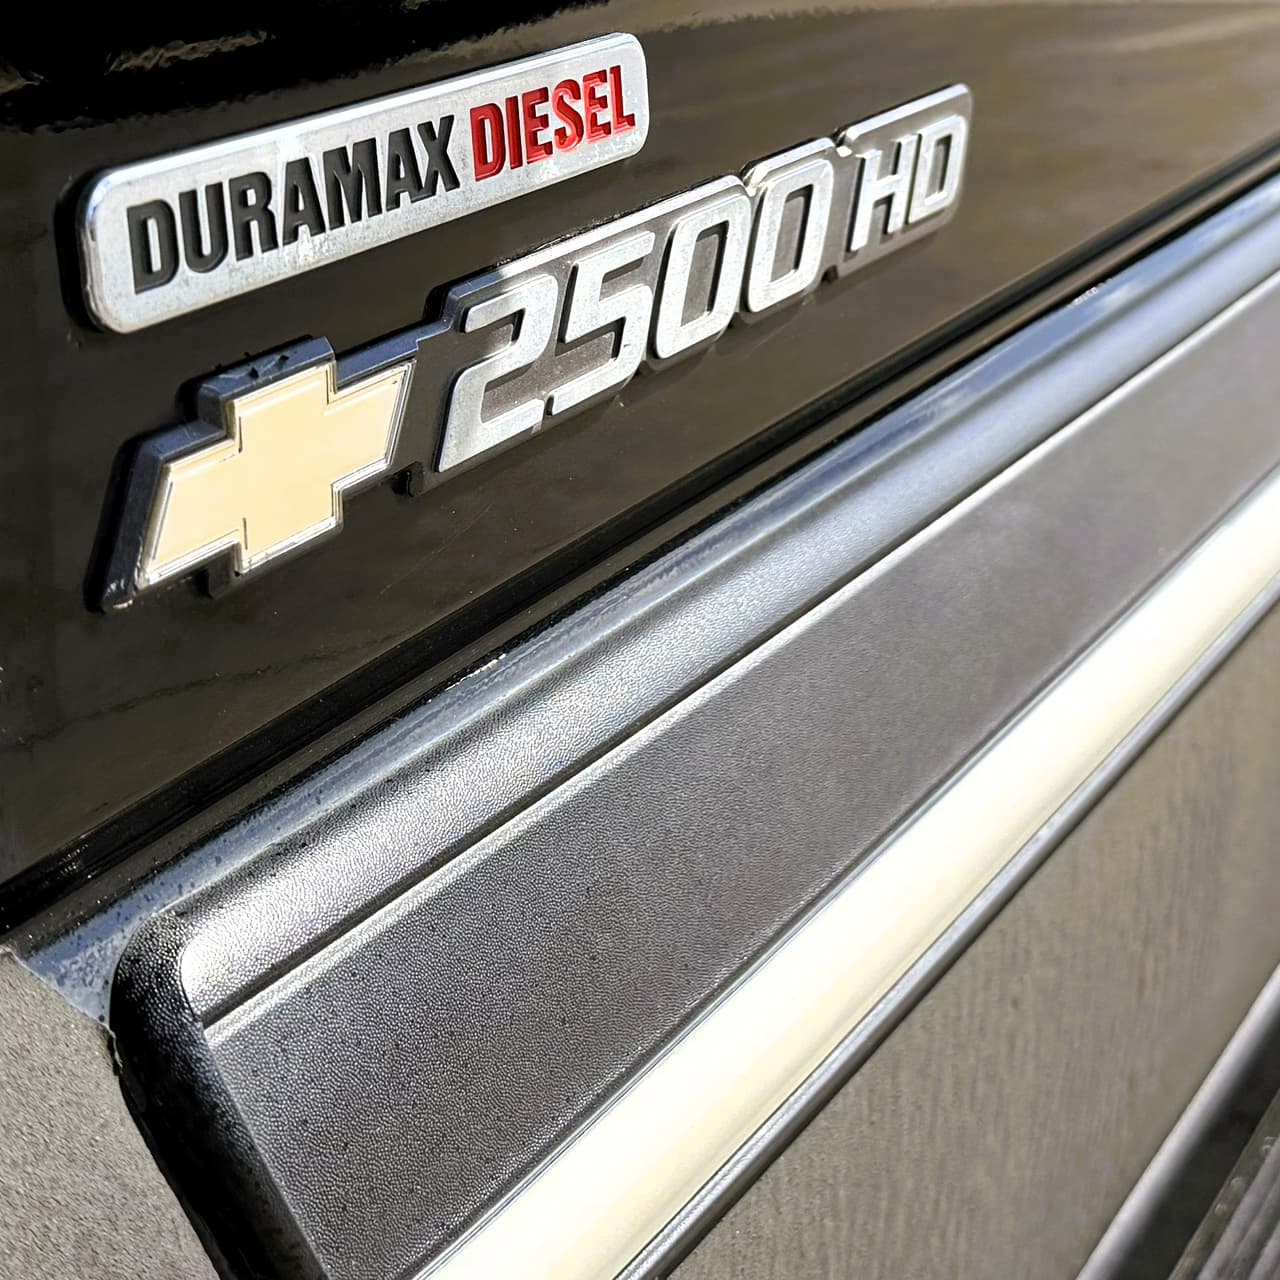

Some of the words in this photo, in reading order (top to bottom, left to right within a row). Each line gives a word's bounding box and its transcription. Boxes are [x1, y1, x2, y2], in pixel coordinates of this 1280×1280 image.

[127, 114, 461, 294] DURAMAX
[470, 65, 637, 182] DIESEL
[436, 156, 834, 473] 2500
[848, 114, 968, 252] HD
